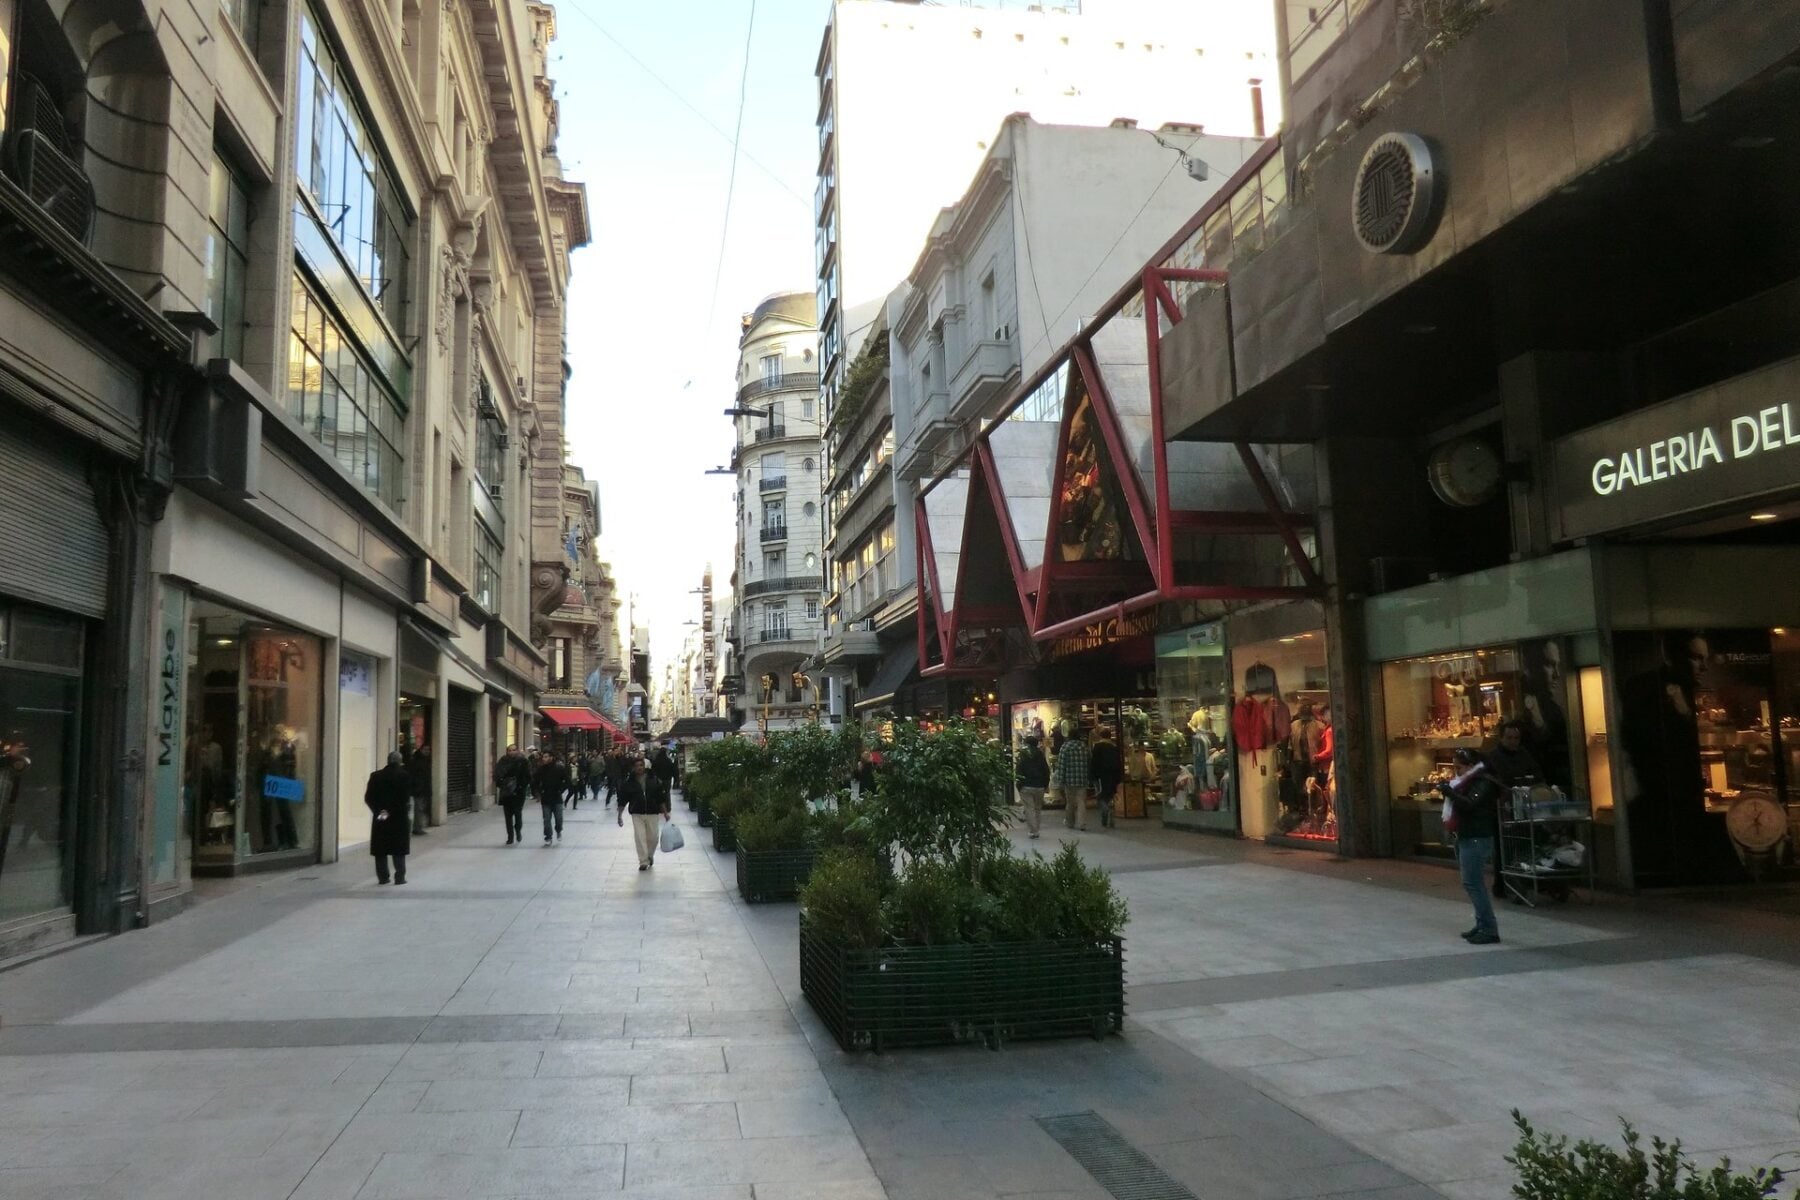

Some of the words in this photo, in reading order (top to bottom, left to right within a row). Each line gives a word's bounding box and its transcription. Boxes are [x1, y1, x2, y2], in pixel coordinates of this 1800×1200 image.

[1592, 427, 1723, 496] GALERIA
[1731, 403, 1800, 459] DEL
[158, 628, 177, 765] Maybe
